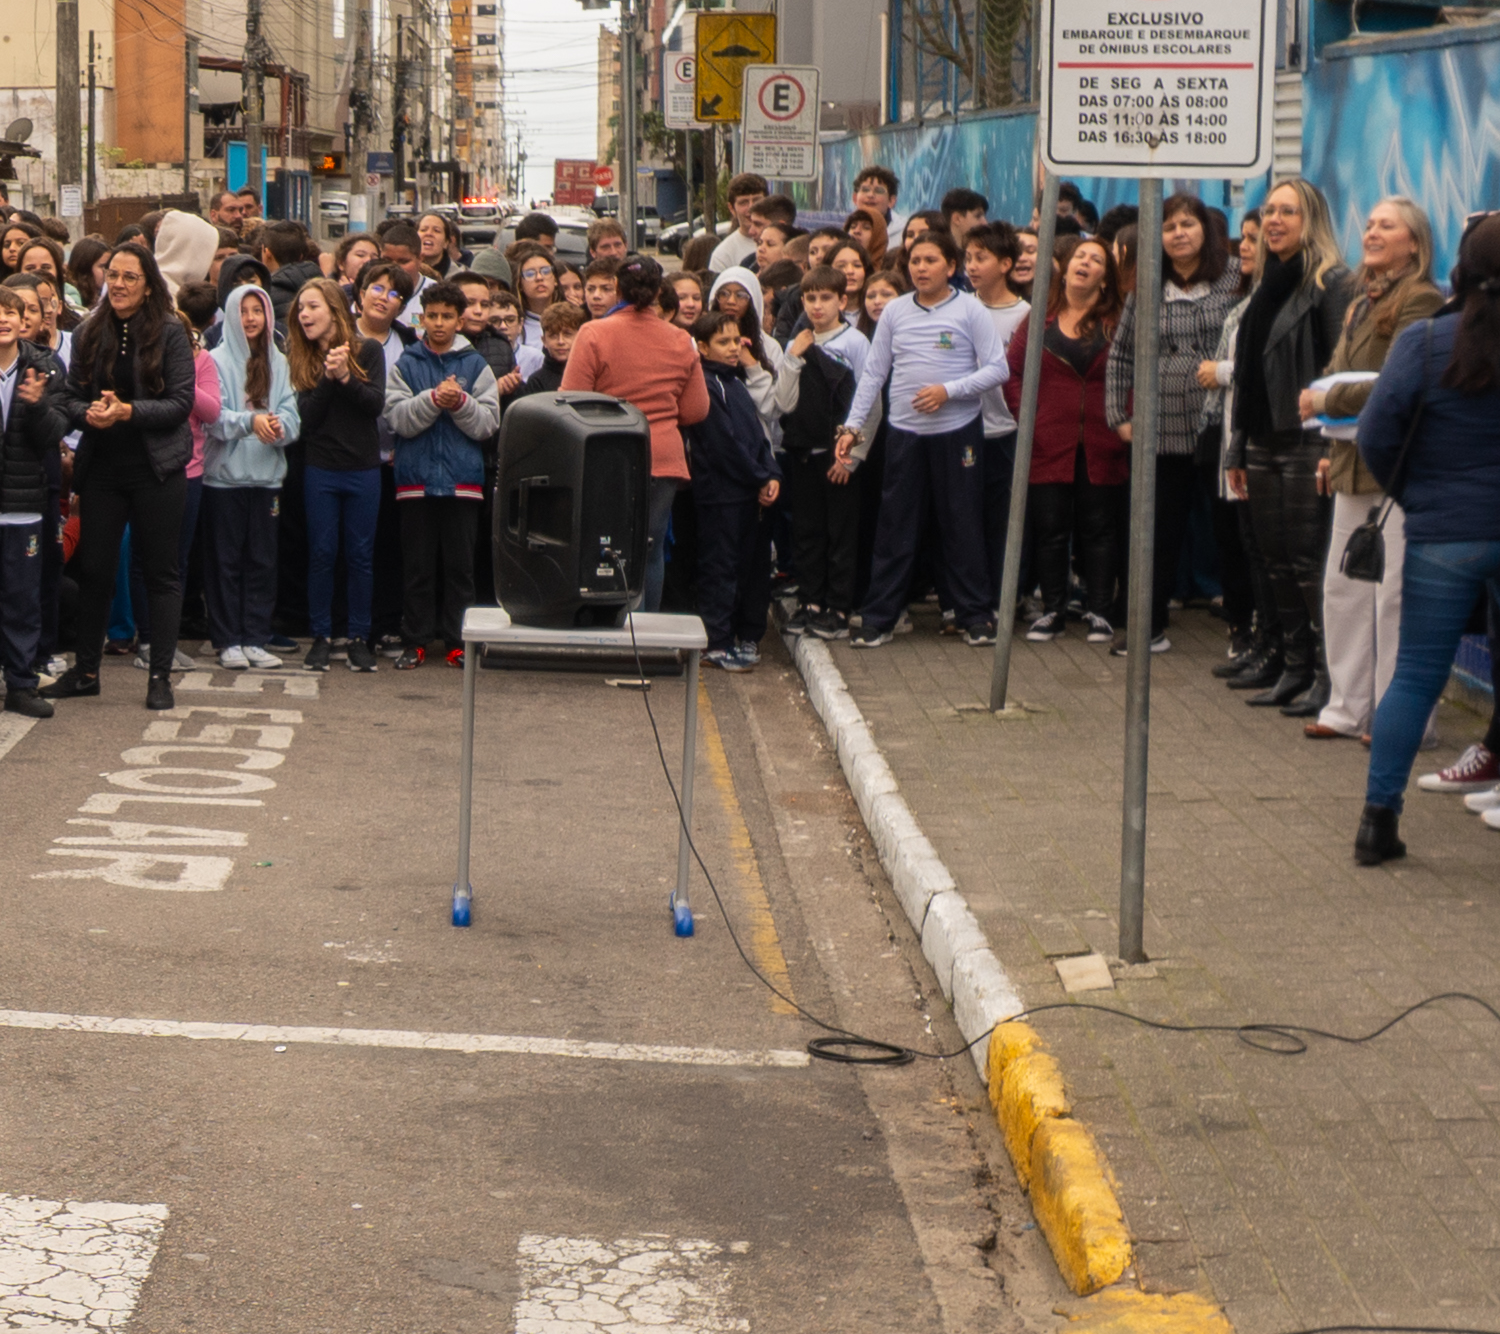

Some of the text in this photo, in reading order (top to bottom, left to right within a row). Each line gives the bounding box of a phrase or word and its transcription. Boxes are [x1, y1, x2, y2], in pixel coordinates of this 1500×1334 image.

[1107, 12, 1204, 26] EXCLUSIVO
[1062, 29, 1251, 40] EMBARQUE E DESEMBARQUE
[1079, 41, 1232, 55] DE ÔNIBUS ESCOLARES
[1079, 77, 1229, 90] DE SEG A SEXTA
[773, 83, 790, 112] E
[1079, 92, 1228, 108] DAS 07:00 ÀS 08:00
[1078, 111, 1228, 126] DAS 11:00 ÀS 14:00
[1078, 128, 1227, 144] DAS 16:30 ÀS 18:00
[30, 705, 304, 892] ESCOLAR
